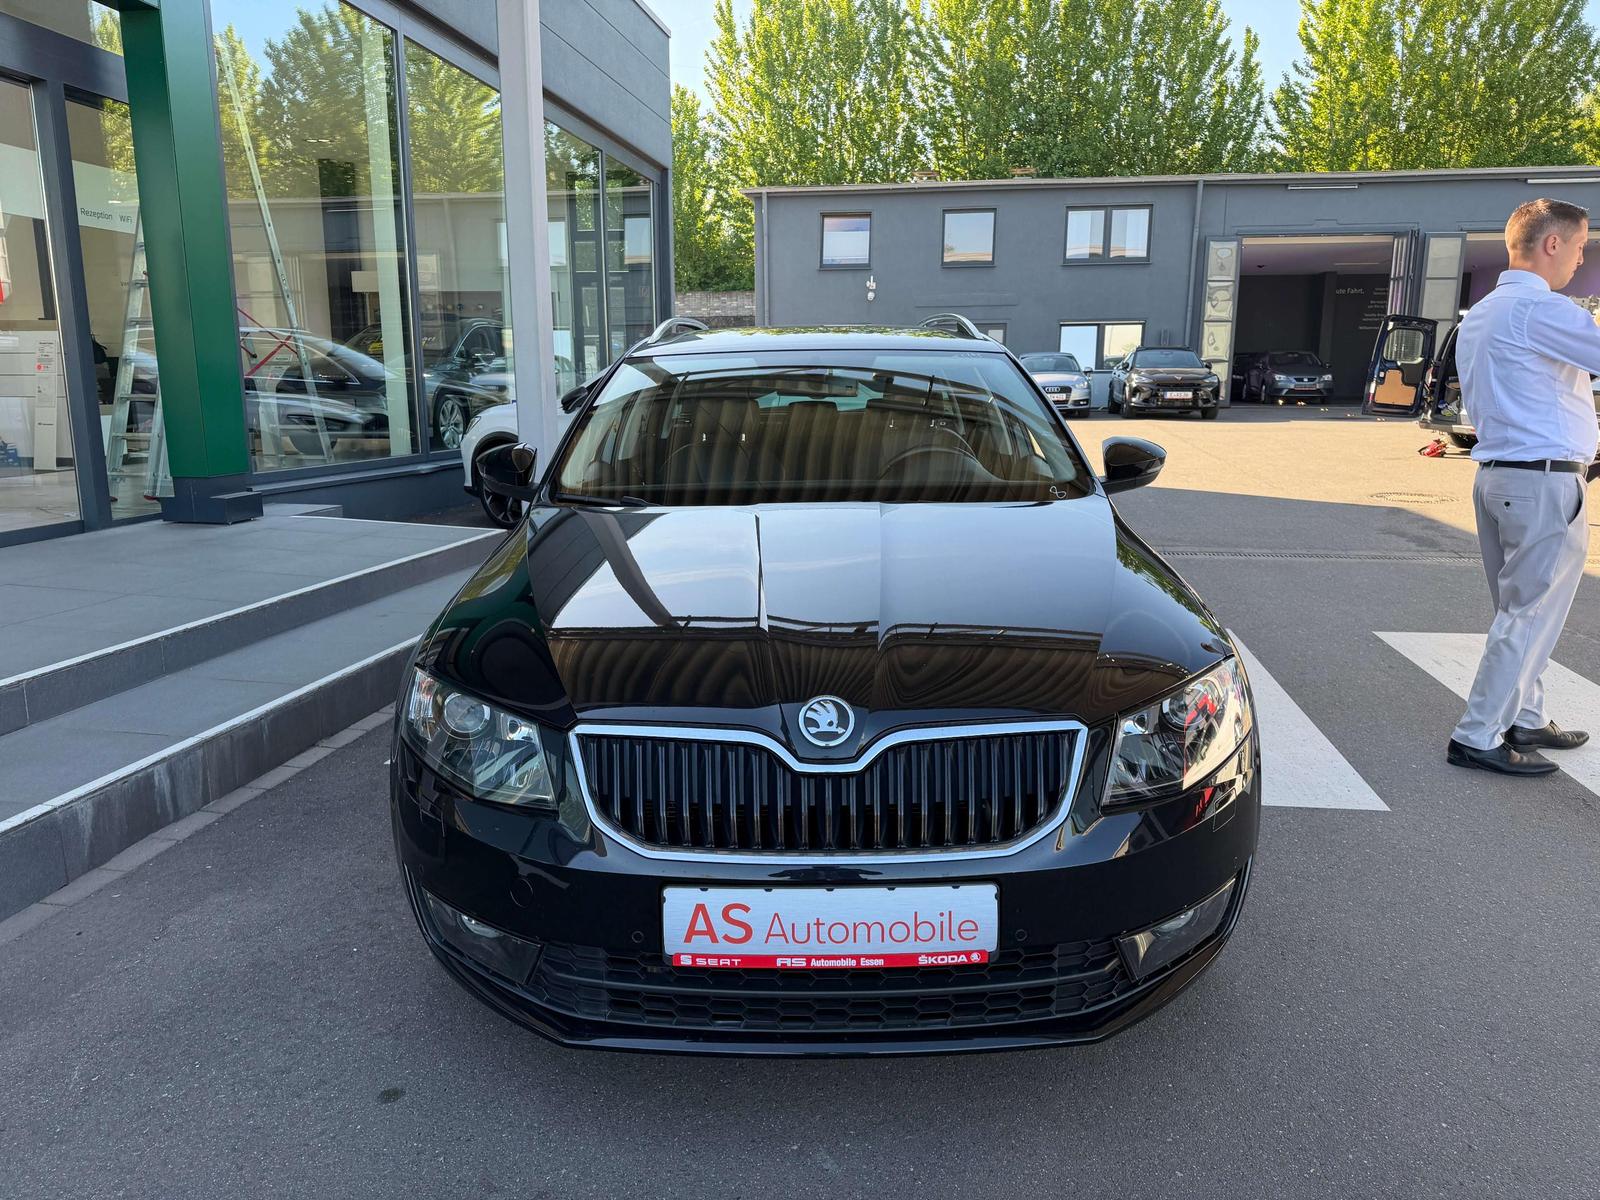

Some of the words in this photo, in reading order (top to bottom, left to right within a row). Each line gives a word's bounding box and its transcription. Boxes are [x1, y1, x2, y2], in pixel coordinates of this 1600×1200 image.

[80, 208, 113, 220] Rezeption
[684, 903, 753, 944] AS
[765, 910, 979, 944] Automobile
[696, 958, 742, 967] SEAT
[811, 957, 856, 967] Automobile
[861, 957, 884, 967] Essen
[918, 954, 968, 965] ŠKODA
